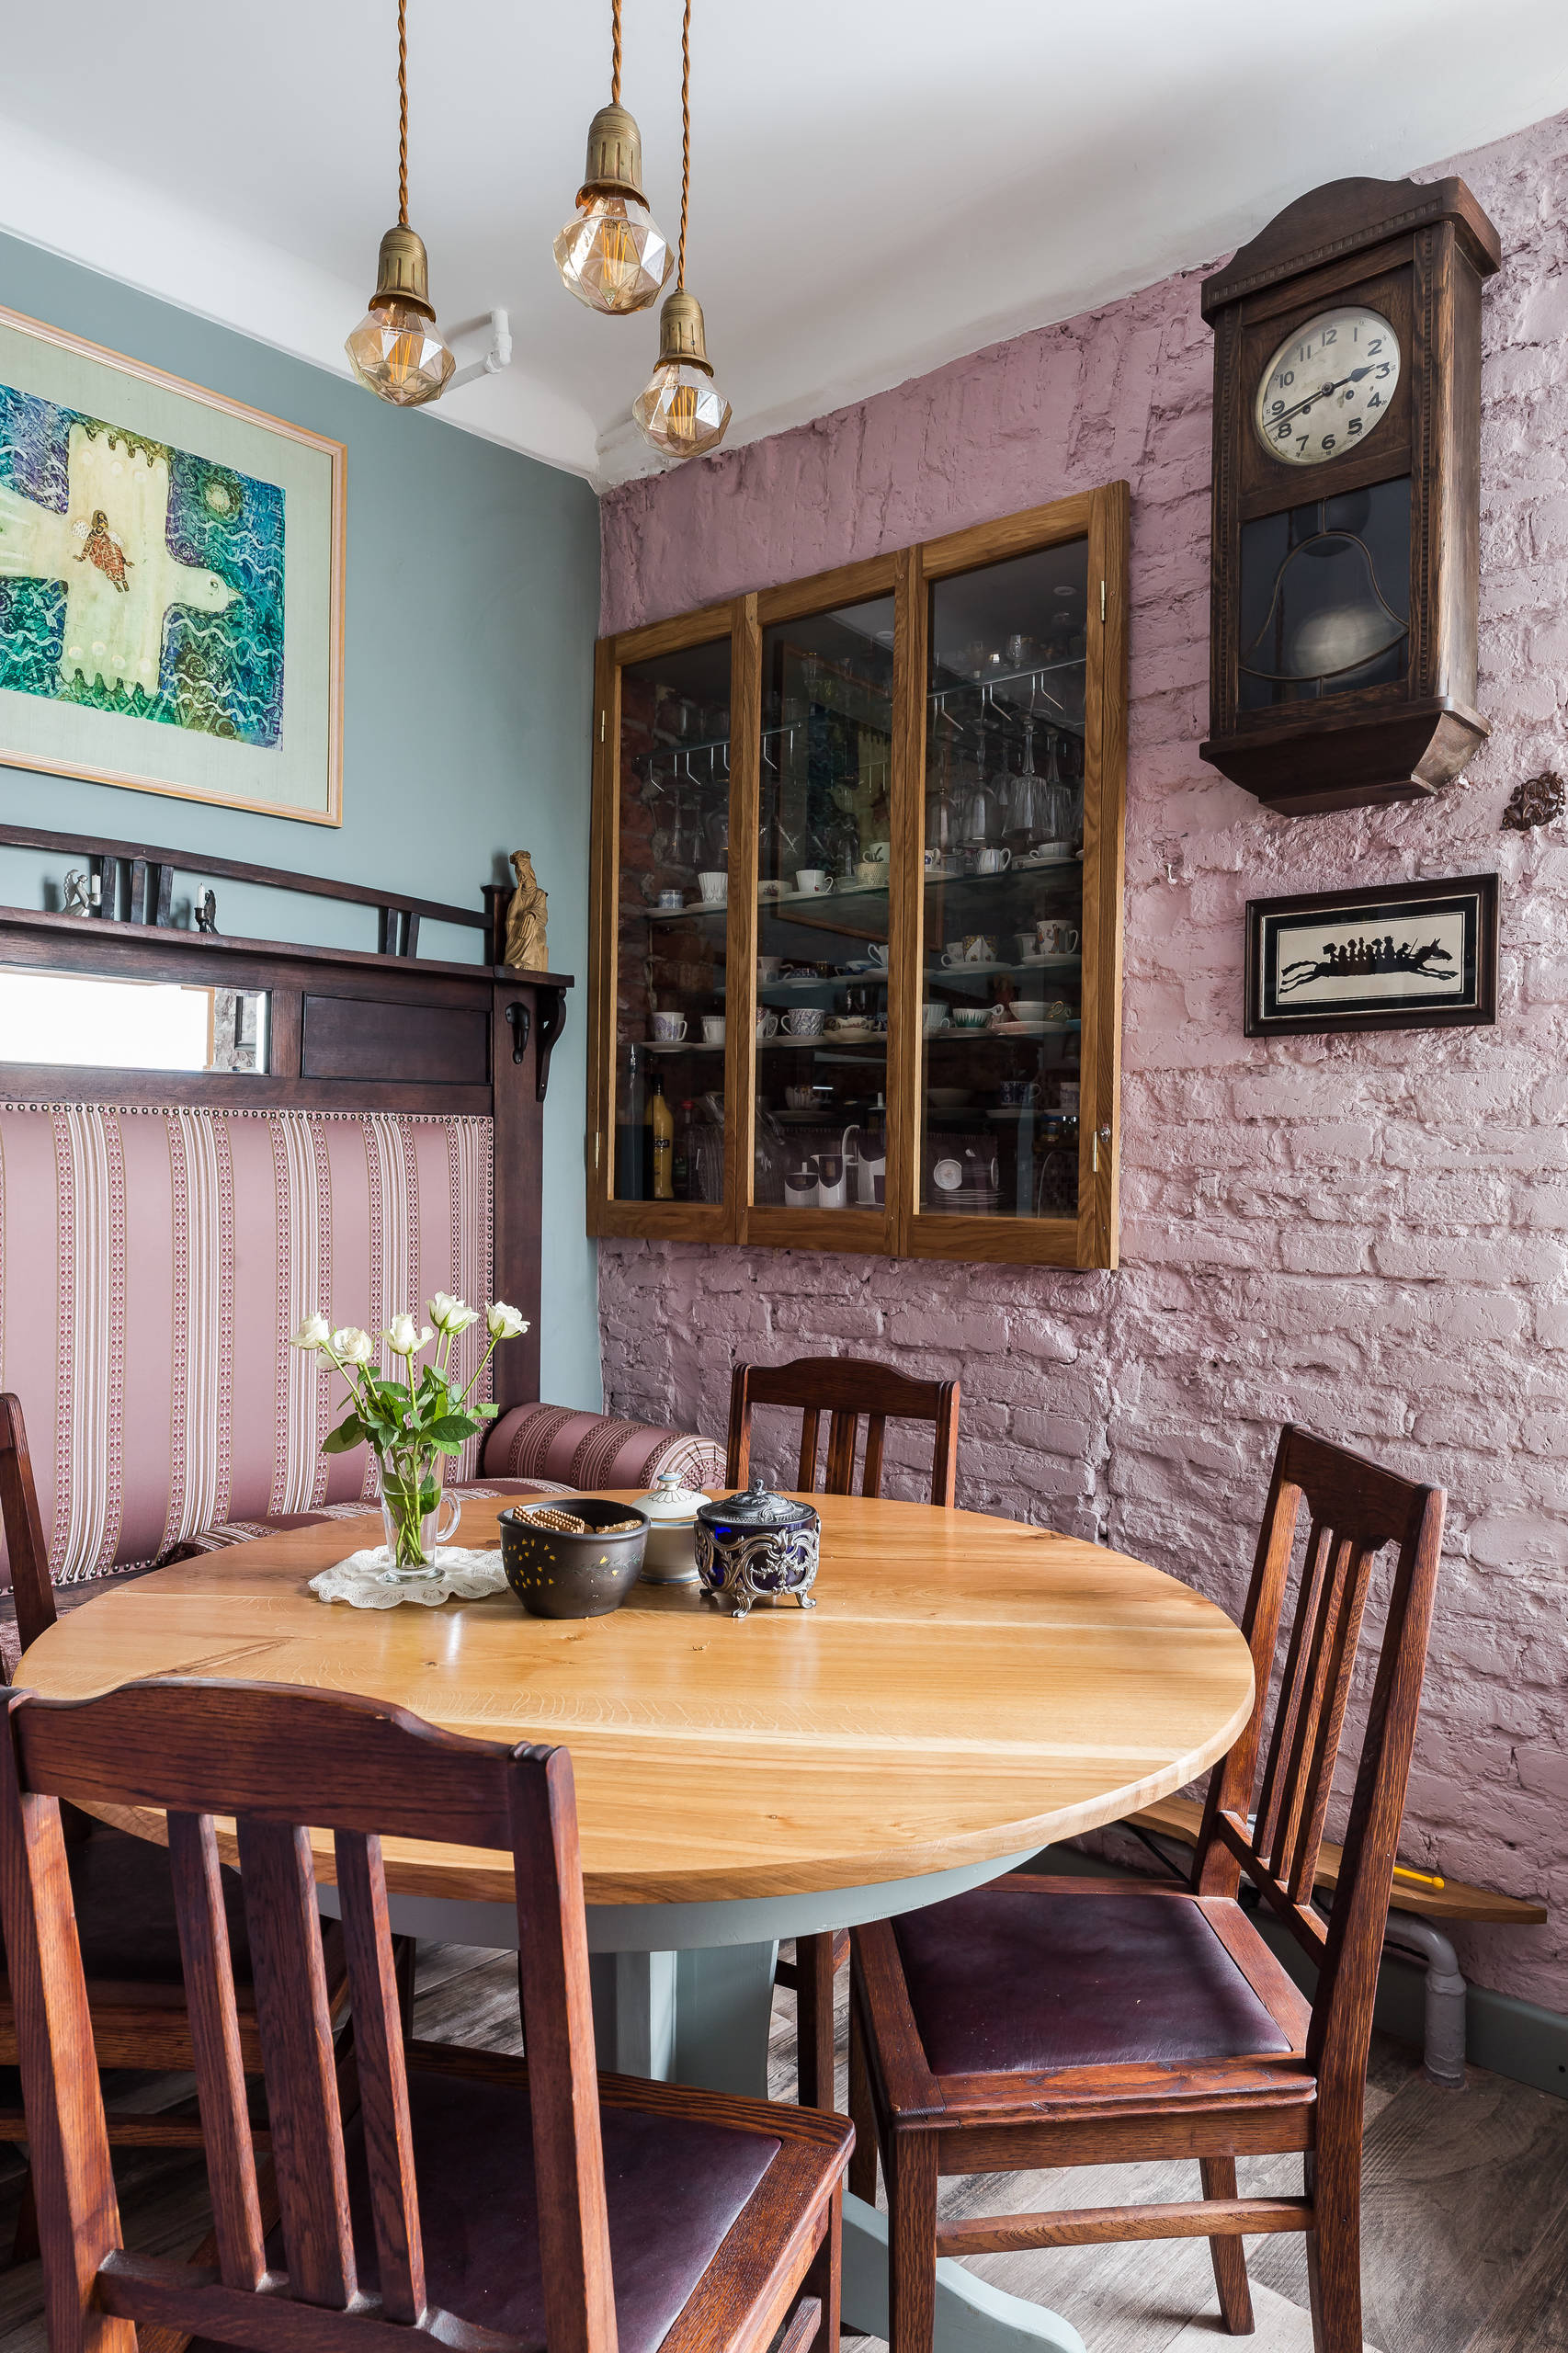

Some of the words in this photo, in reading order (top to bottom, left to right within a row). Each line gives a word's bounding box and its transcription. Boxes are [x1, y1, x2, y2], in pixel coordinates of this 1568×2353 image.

[1322, 329, 1337, 347] 12
[1353, 326, 1358, 342] 1
[1300, 345, 1312, 362] 11
[1368, 338, 1382, 357] 2
[1375, 361, 1391, 379] 3
[1279, 370, 1295, 389] 10
[1271, 400, 1286, 415] 9
[1367, 392, 1382, 408] 4
[1278, 423, 1292, 438] 8
[1346, 417, 1363, 436] 5
[1295, 434, 1310, 451] 7
[1322, 434, 1336, 450] 6
